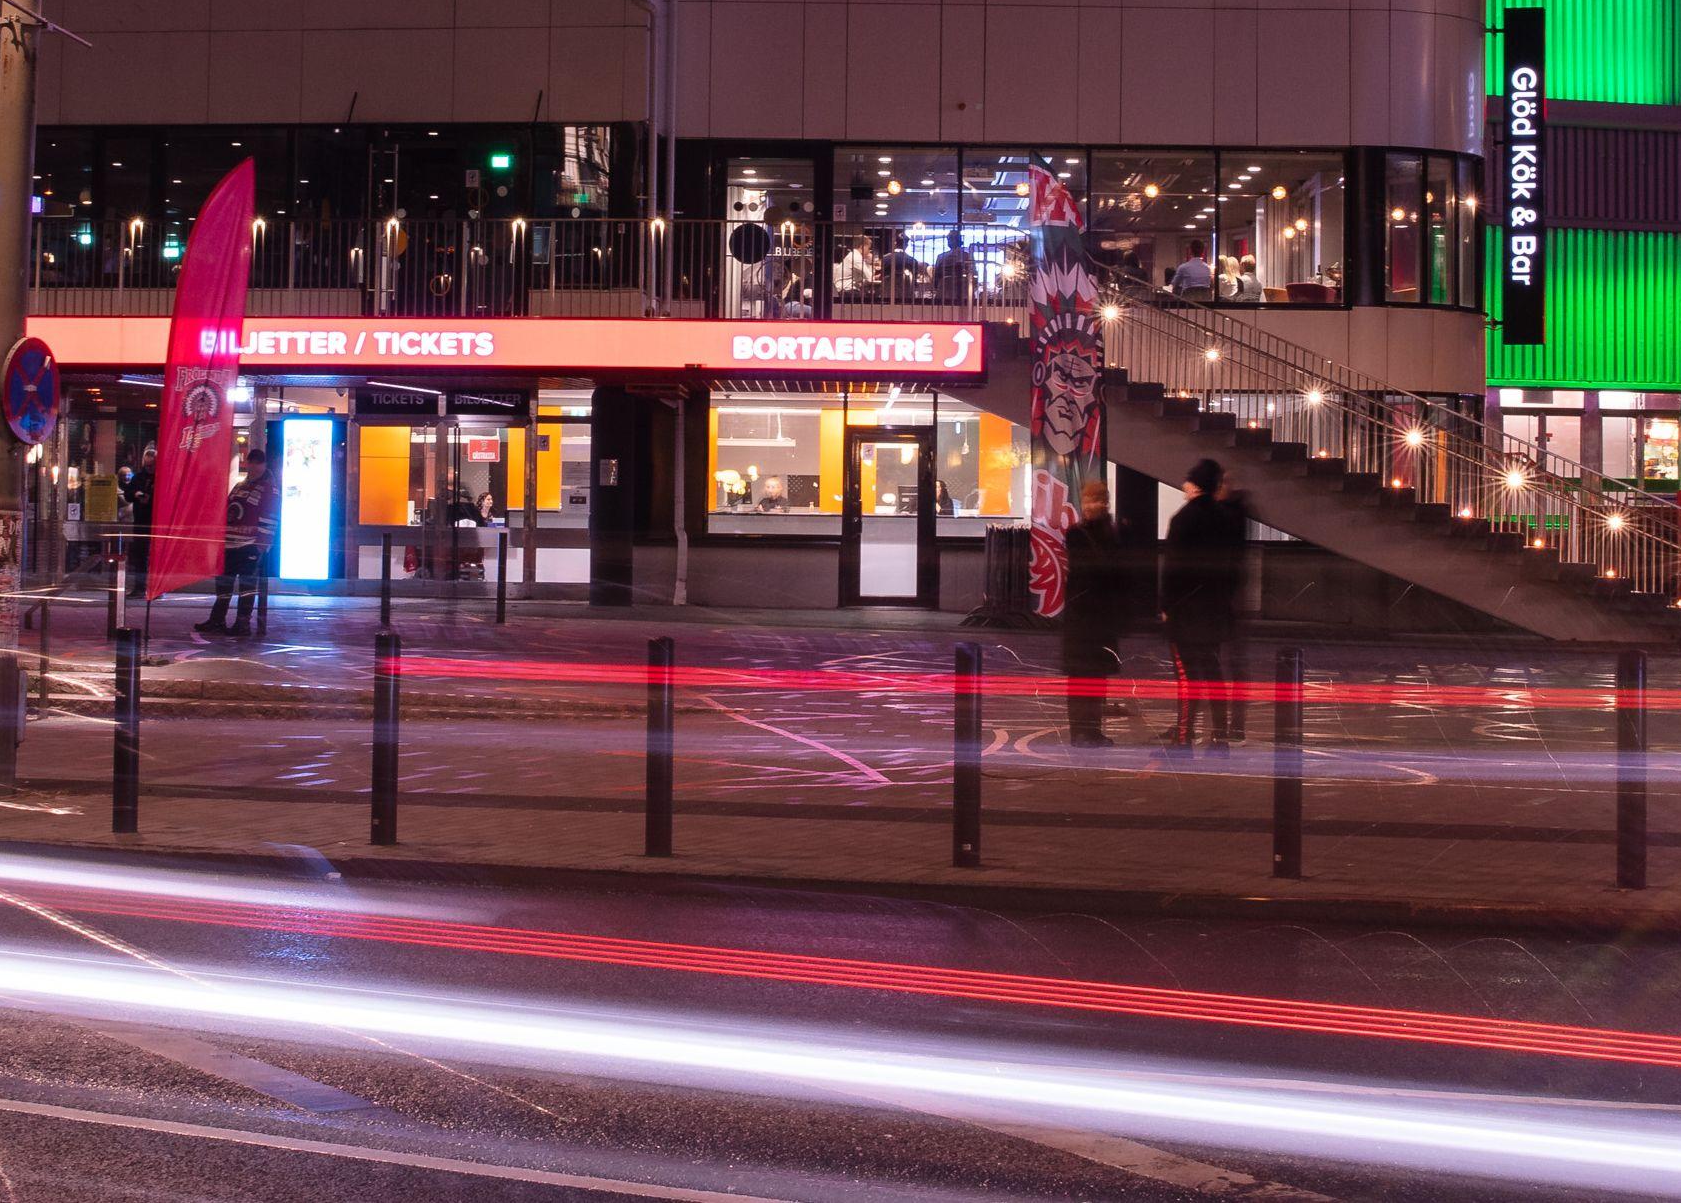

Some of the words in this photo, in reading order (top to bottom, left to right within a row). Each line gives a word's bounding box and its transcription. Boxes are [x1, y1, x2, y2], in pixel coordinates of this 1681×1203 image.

[1511, 66, 1538, 136] Glöd
[1511, 145, 1537, 200] Kök
[1511, 207, 1537, 227] &
[1511, 235, 1537, 286] Bar
[200, 331, 347, 355] BILJETTER
[373, 331, 494, 356] TICKETS
[732, 333, 933, 362] BORTAENTRÉ
[372, 393, 424, 405] TICKETS
[454, 393, 522, 405] BILJETTER
